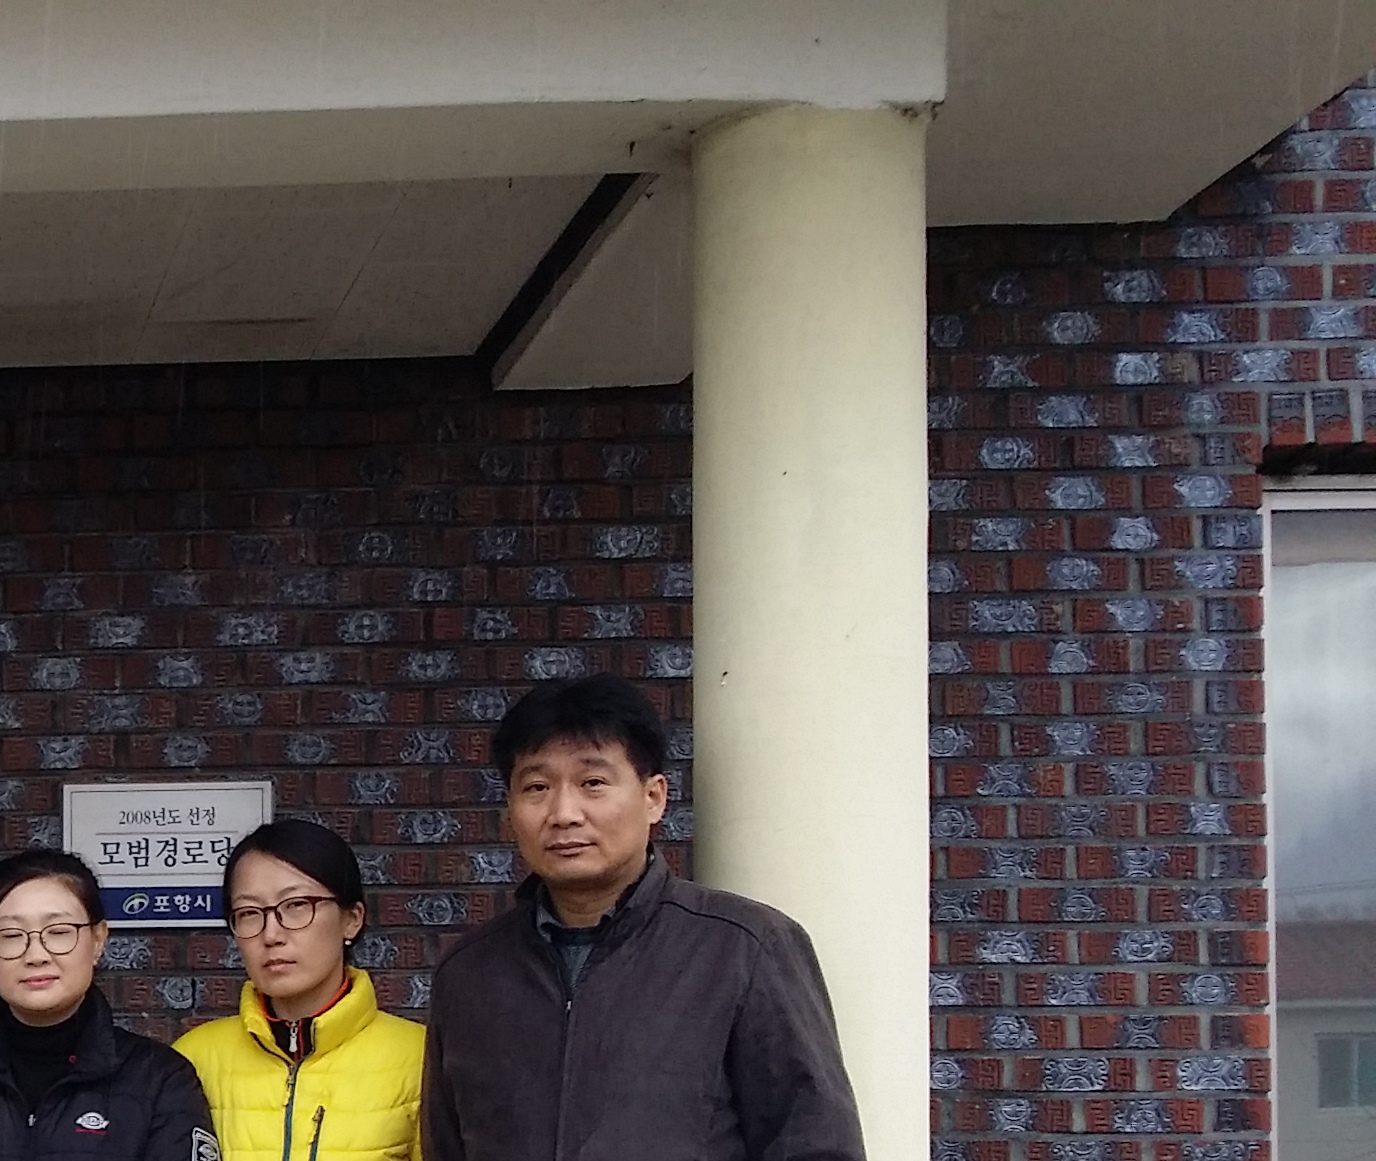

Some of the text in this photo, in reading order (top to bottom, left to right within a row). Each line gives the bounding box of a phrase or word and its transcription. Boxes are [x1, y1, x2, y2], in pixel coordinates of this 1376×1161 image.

[118, 806, 217, 826] 2008년도 선정
[98, 836, 234, 869] 모범경로당
[152, 893, 212, 913] 포항시
